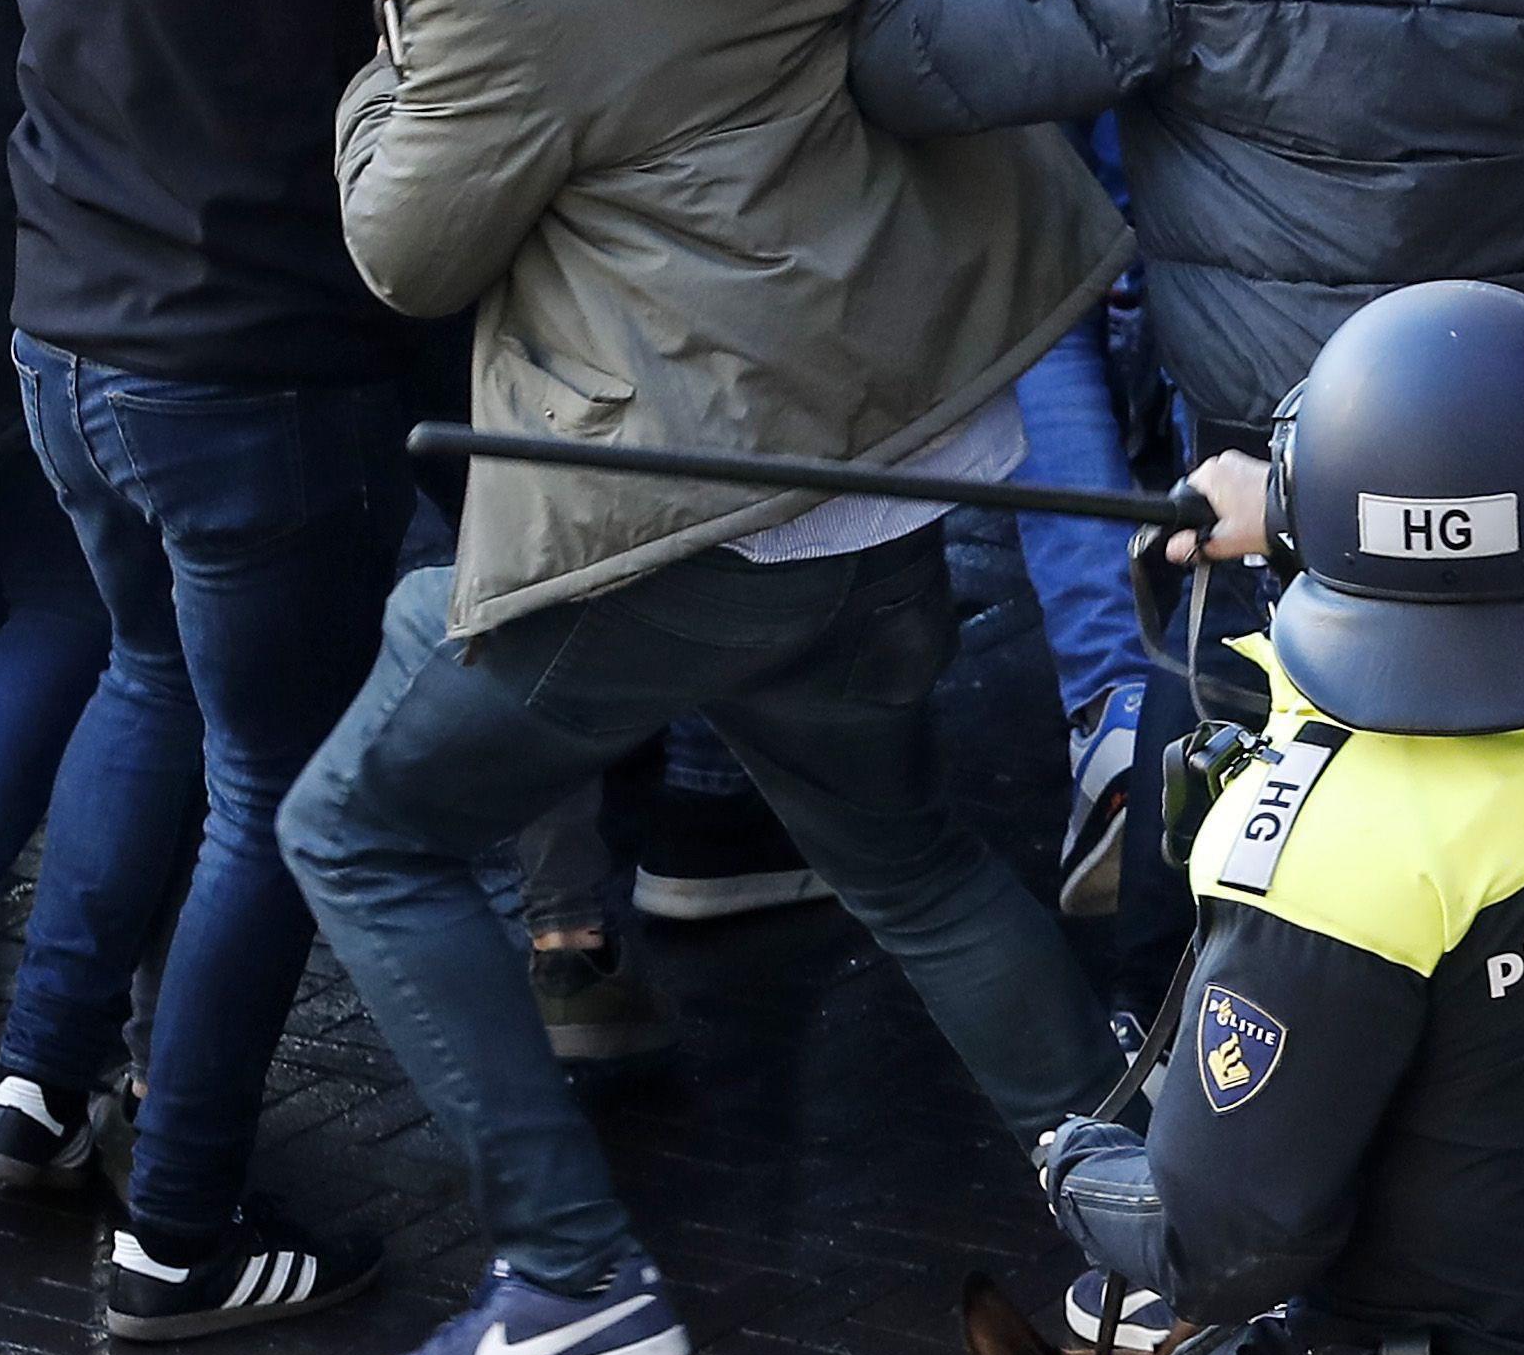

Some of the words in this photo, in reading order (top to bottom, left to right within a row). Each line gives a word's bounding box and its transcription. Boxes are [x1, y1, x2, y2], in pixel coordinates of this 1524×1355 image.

[1403, 508, 1473, 552] HG
[1244, 779, 1300, 843] HG
[1208, 997, 1277, 1046] POLITIE
